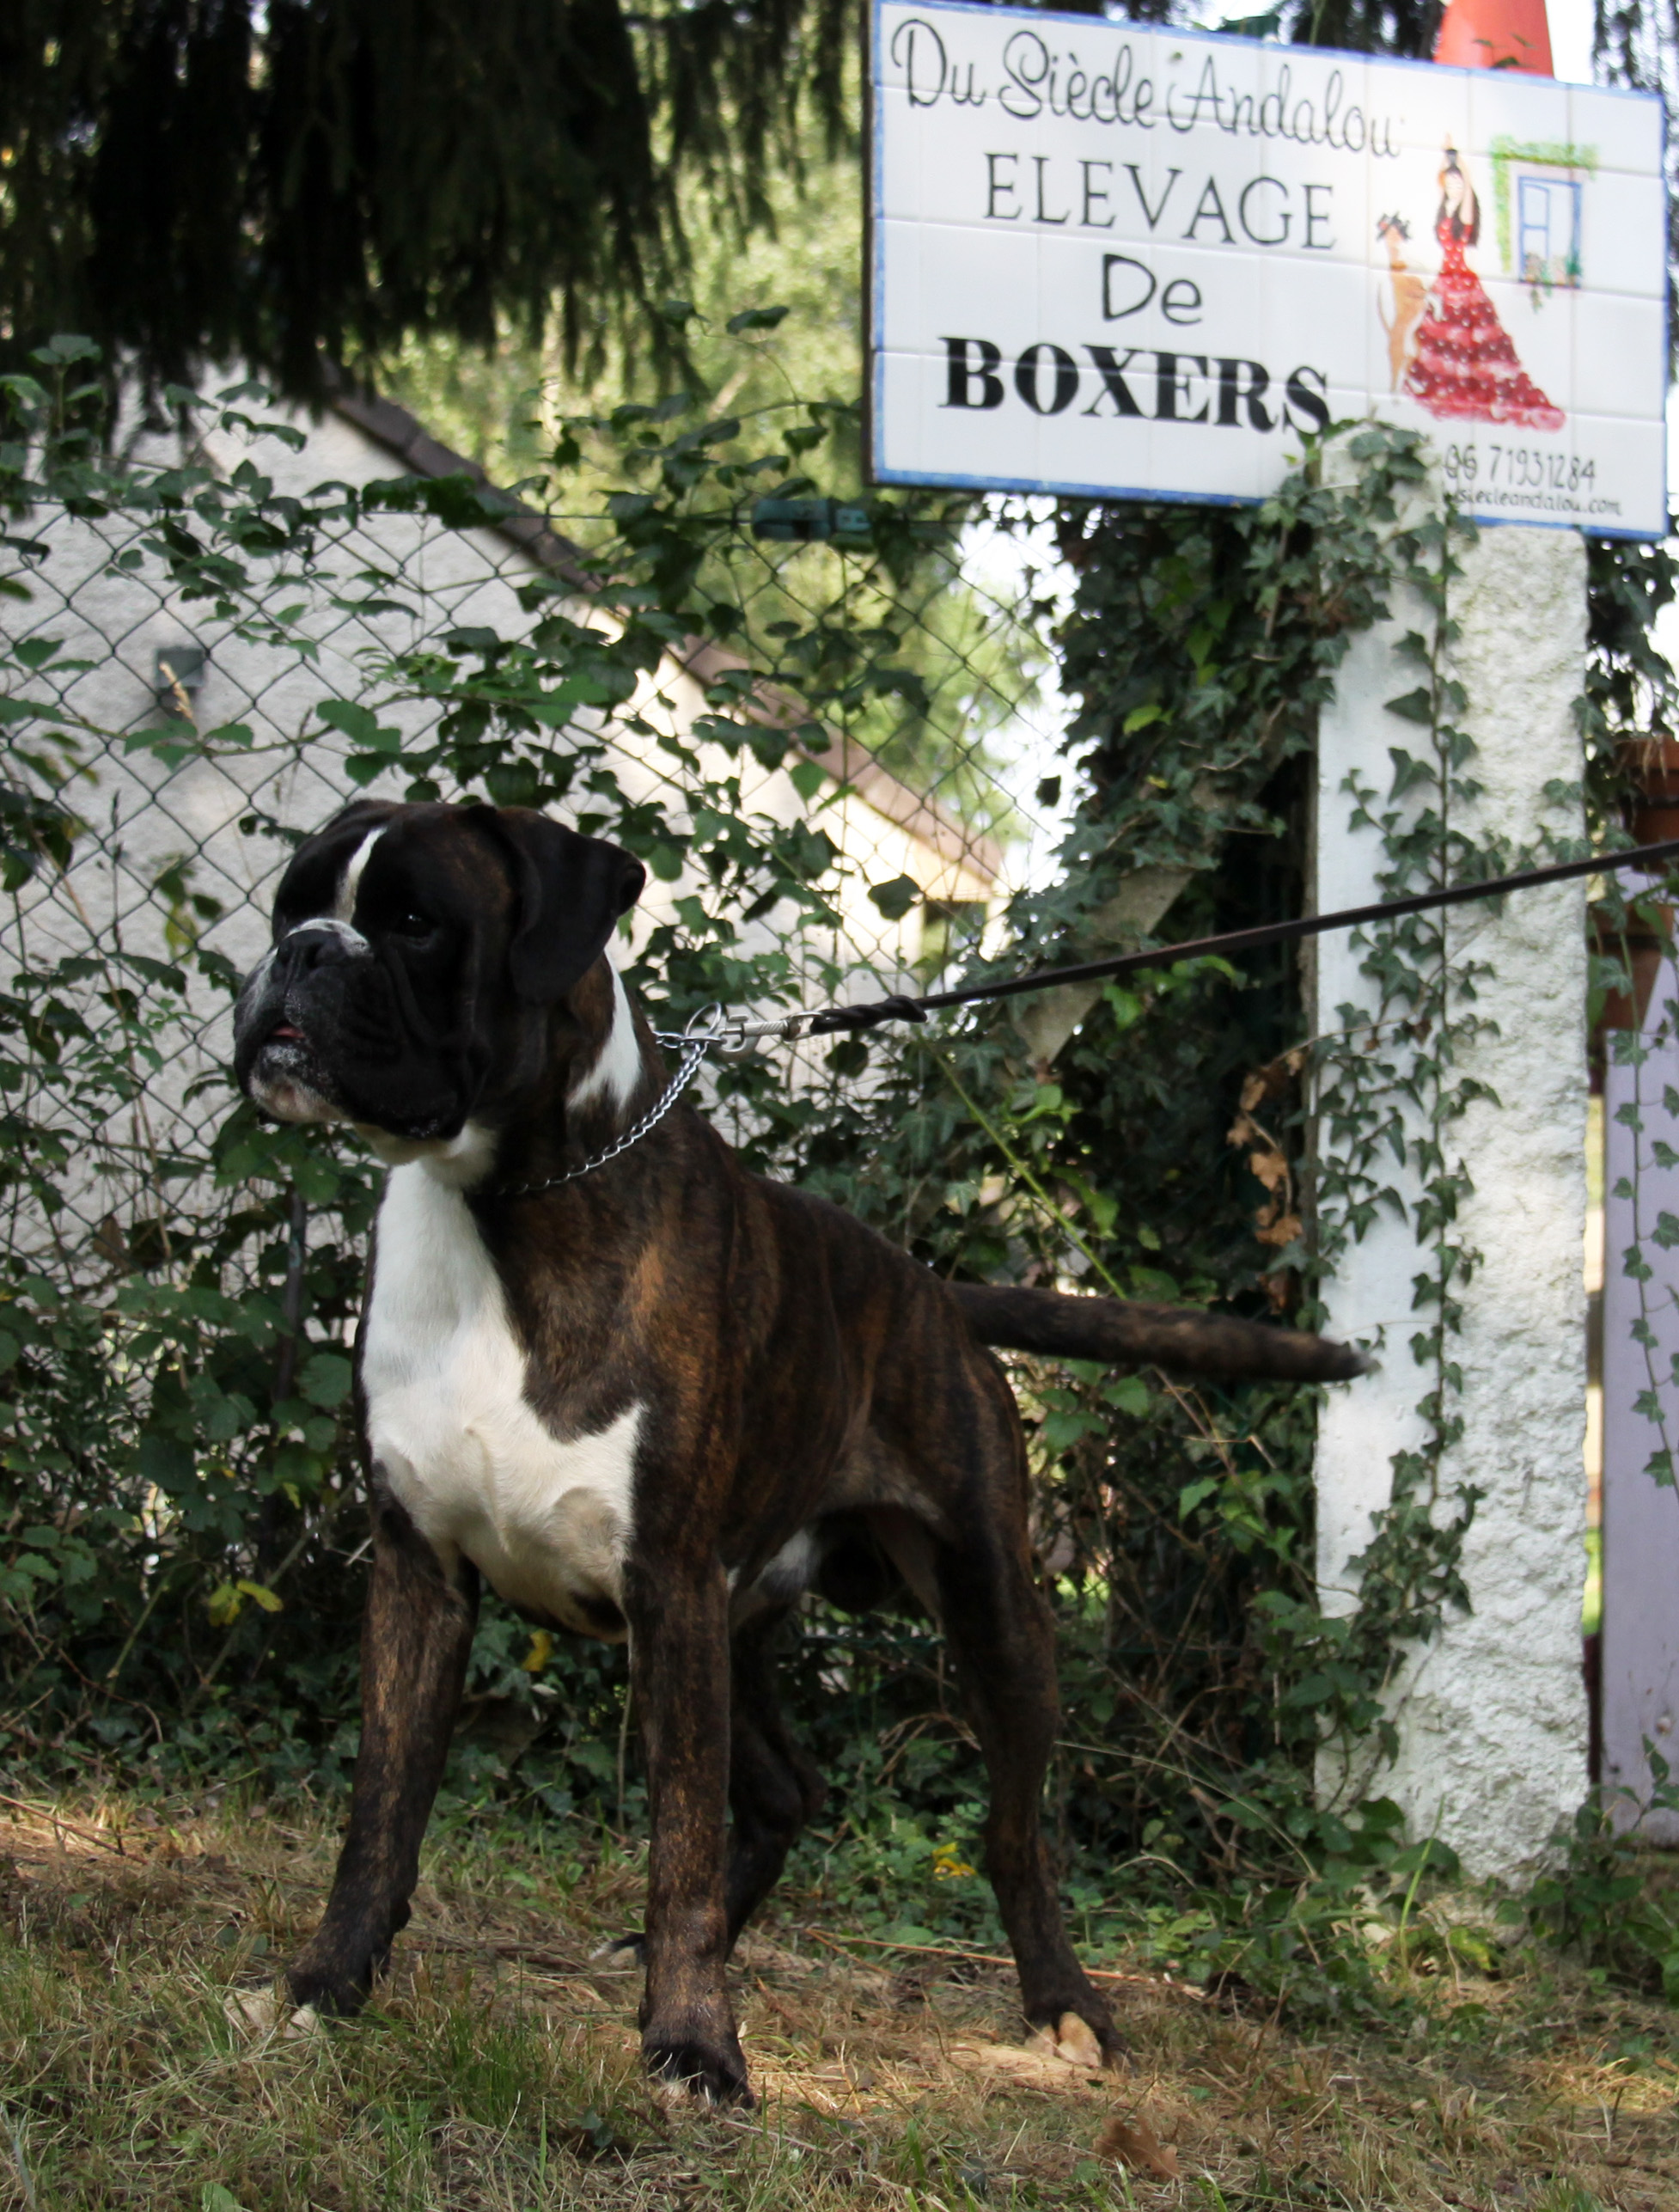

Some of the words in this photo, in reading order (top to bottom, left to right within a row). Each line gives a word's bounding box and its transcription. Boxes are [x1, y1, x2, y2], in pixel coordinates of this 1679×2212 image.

[890, 18, 986, 107] Du
[997, 30, 1156, 129] Siècle
[1166, 54, 1401, 157] Andalou
[982, 151, 1338, 251] ELEVAGE
[1102, 253, 1203, 326] De
[937, 336, 1330, 436] BOXERS
[1451, 486, 1622, 516] siecleandalou.com
